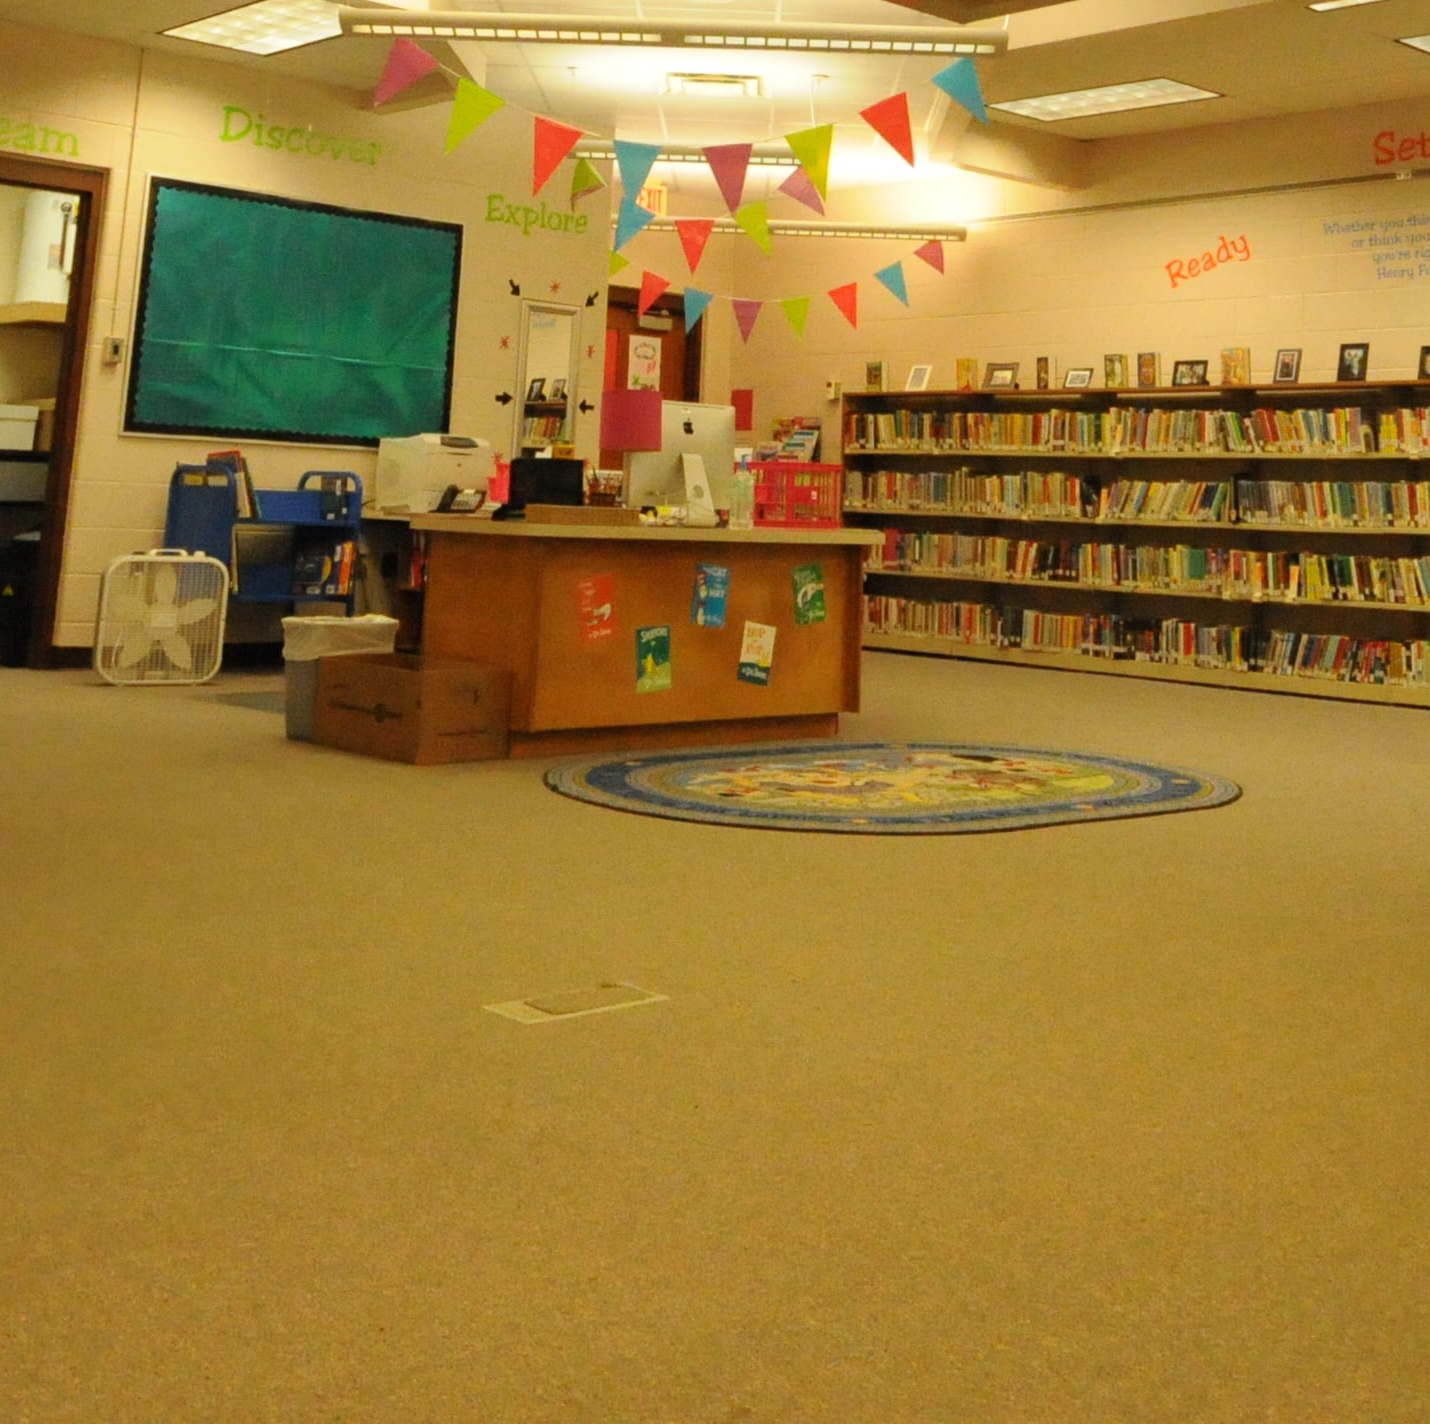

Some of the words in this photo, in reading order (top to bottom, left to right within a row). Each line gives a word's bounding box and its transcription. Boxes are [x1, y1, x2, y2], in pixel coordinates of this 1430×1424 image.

[220, 104, 384, 167] Discover
[485, 192, 589, 236] Explore
[1323, 220, 1375, 235] Whether
[1380, 218, 1404, 232] you
[1351, 237, 1365, 248] or
[1368, 233, 1403, 247] think
[1404, 231, 1430, 245] you
[1164, 234, 1252, 288] Ready
[1372, 250, 1411, 264] you're
[1377, 266, 1414, 280] Henry
